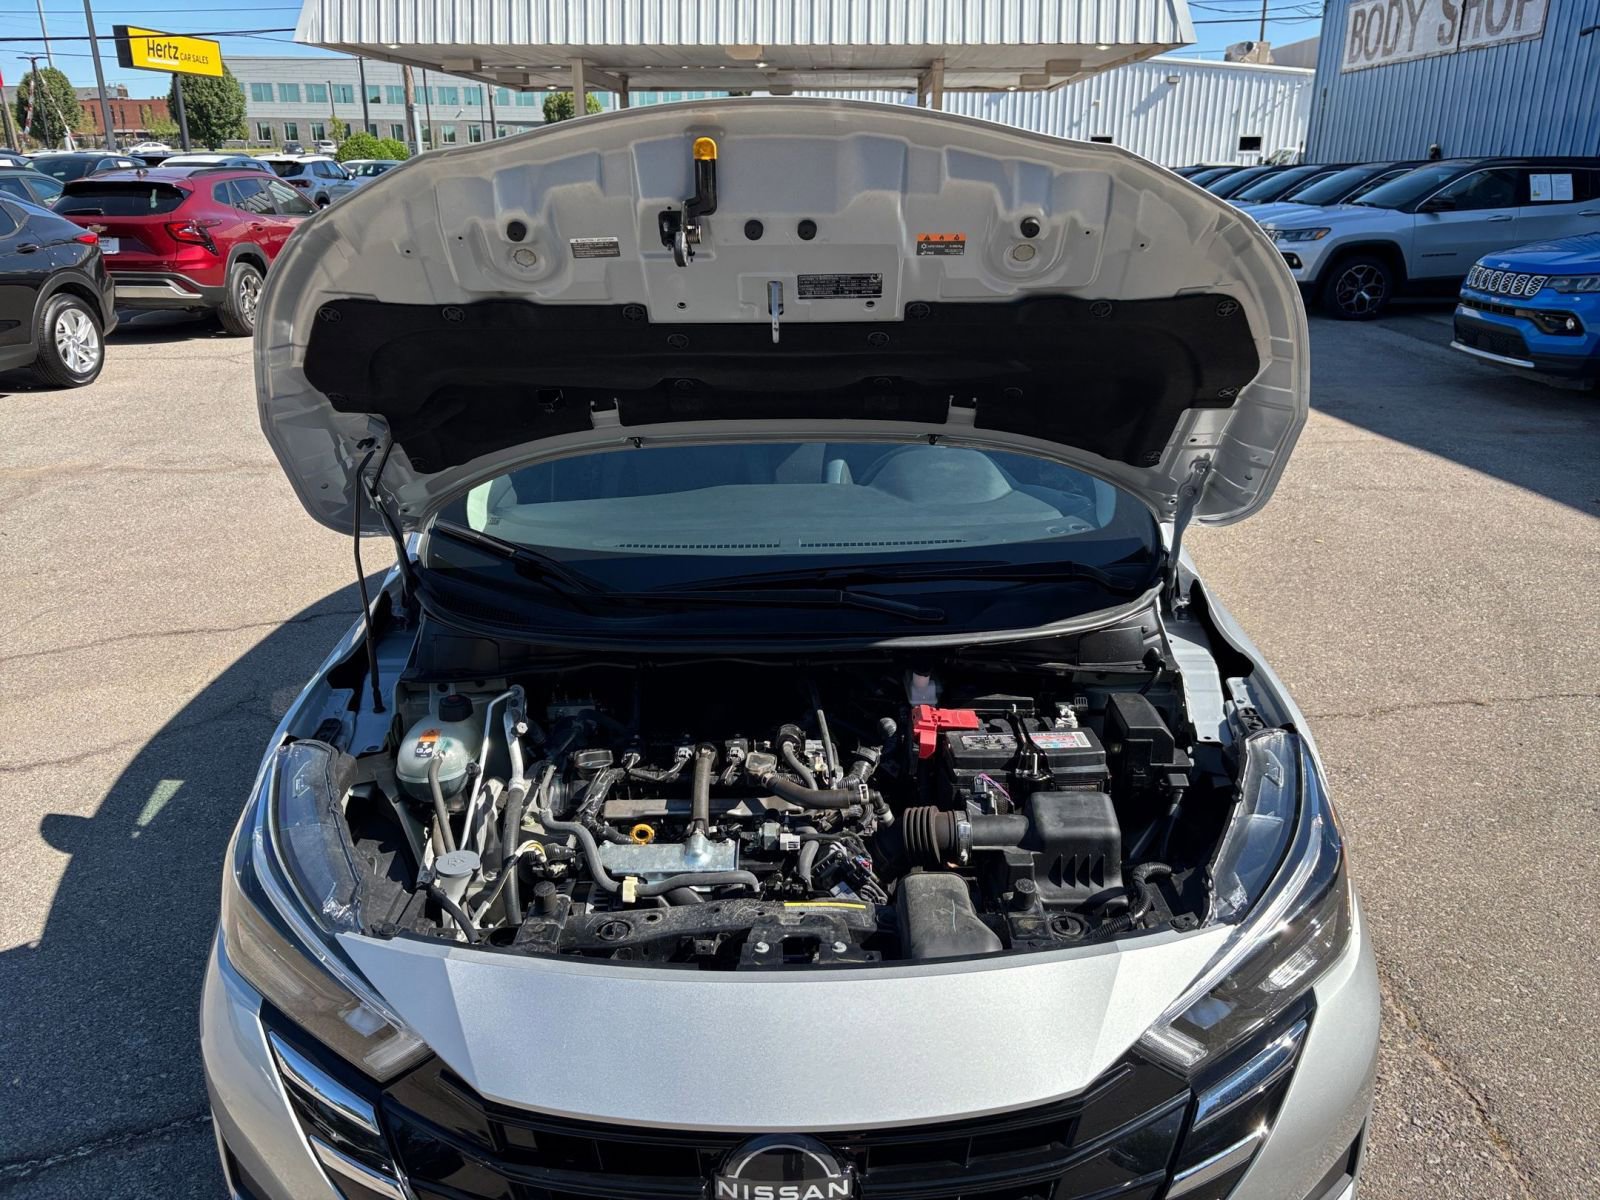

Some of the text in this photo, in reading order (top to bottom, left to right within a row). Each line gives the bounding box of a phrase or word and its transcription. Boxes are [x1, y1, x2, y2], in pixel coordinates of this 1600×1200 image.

[1347, 0, 1426, 64] BODY
[147, 39, 208, 64] Hertz CAR SALES
[717, 1179, 850, 1200] NISSAN
